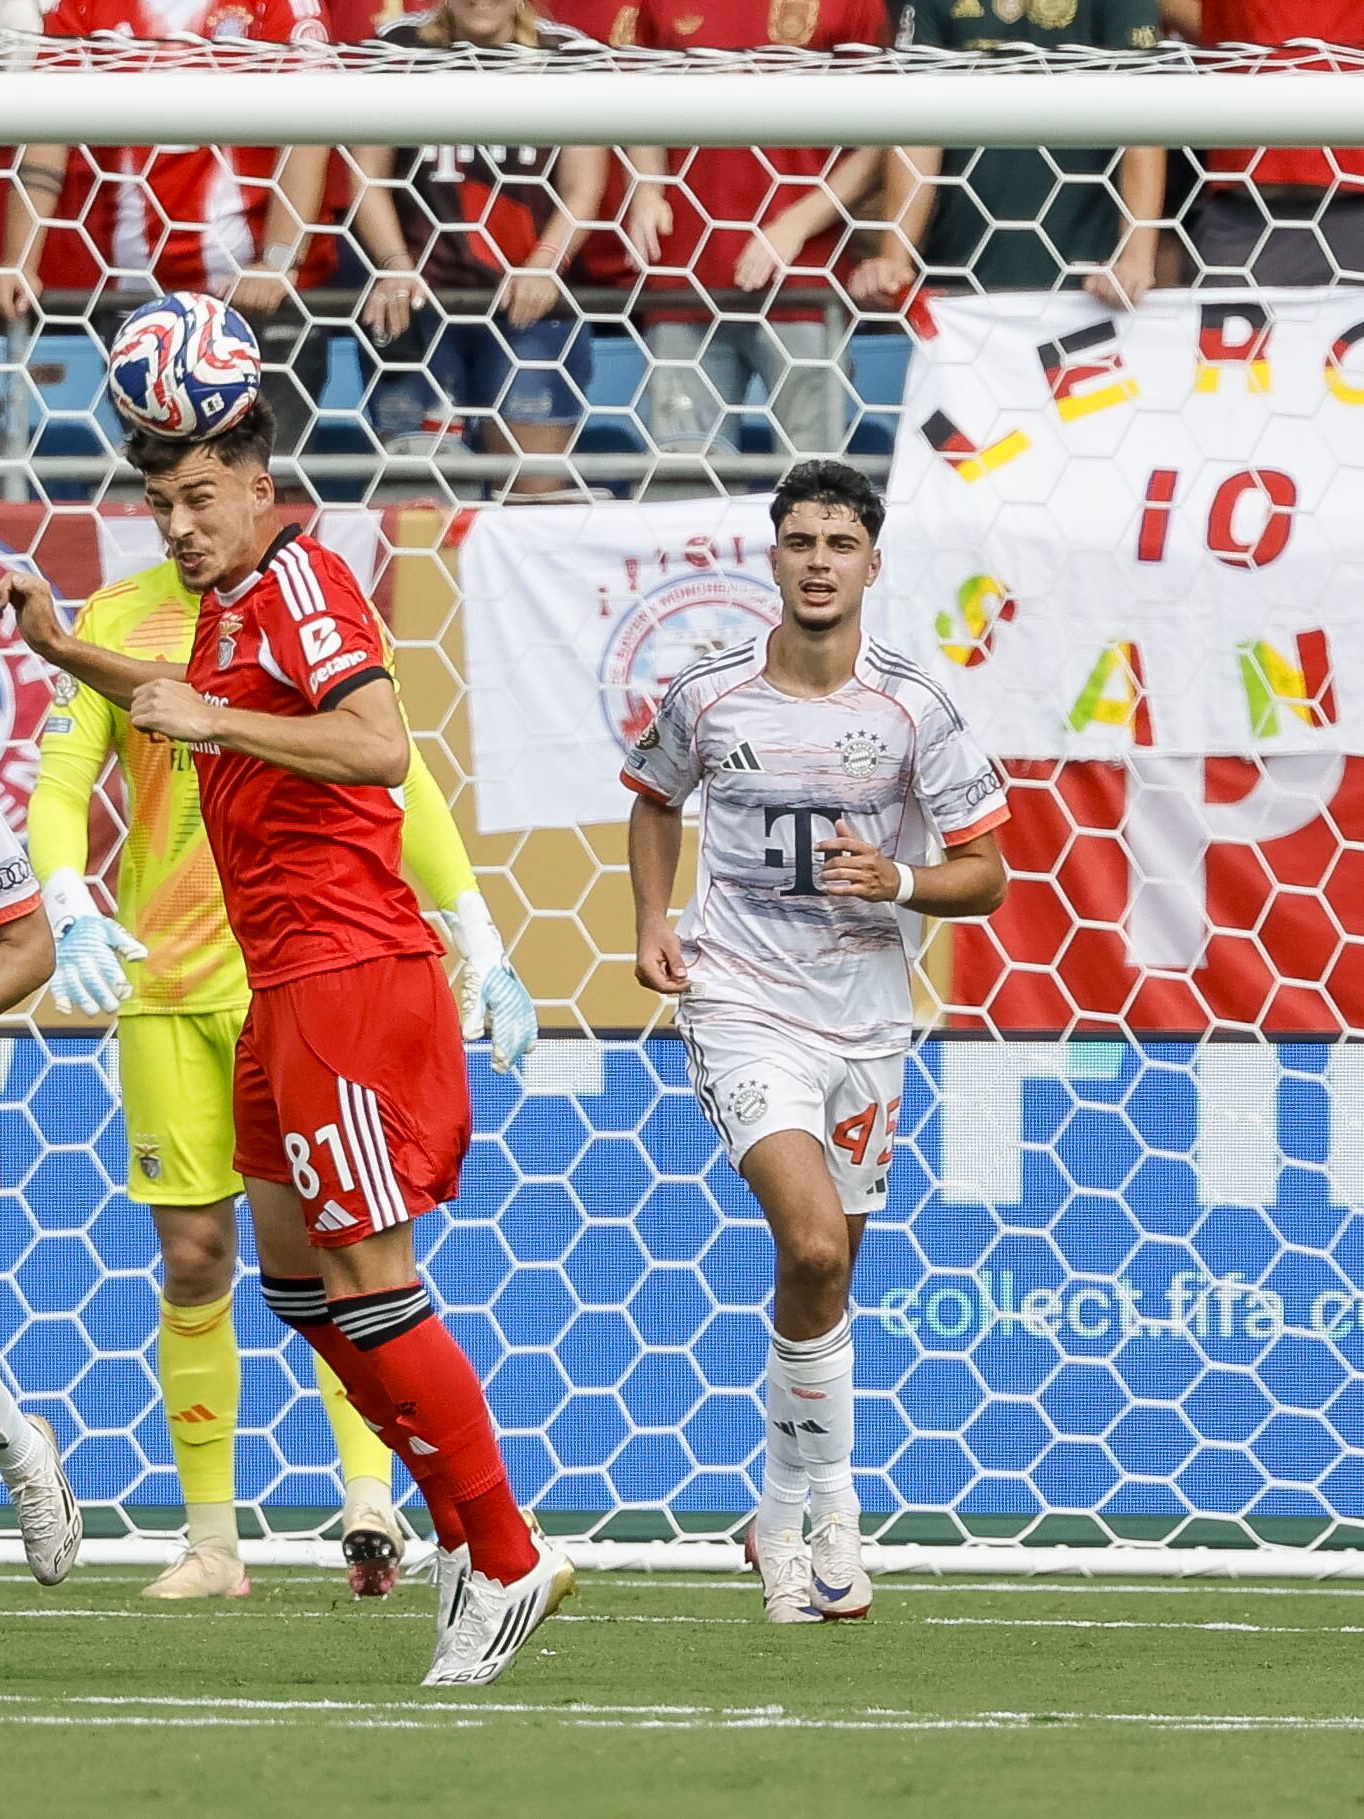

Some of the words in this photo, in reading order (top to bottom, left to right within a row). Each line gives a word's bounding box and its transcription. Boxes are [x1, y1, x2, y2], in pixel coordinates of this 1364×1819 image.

[1137, 468, 1297, 569] 10
[935, 574, 1339, 747] SAN
[284, 1122, 356, 1200] 81
[879, 1268, 1364, 1340] collect.fifa.c
